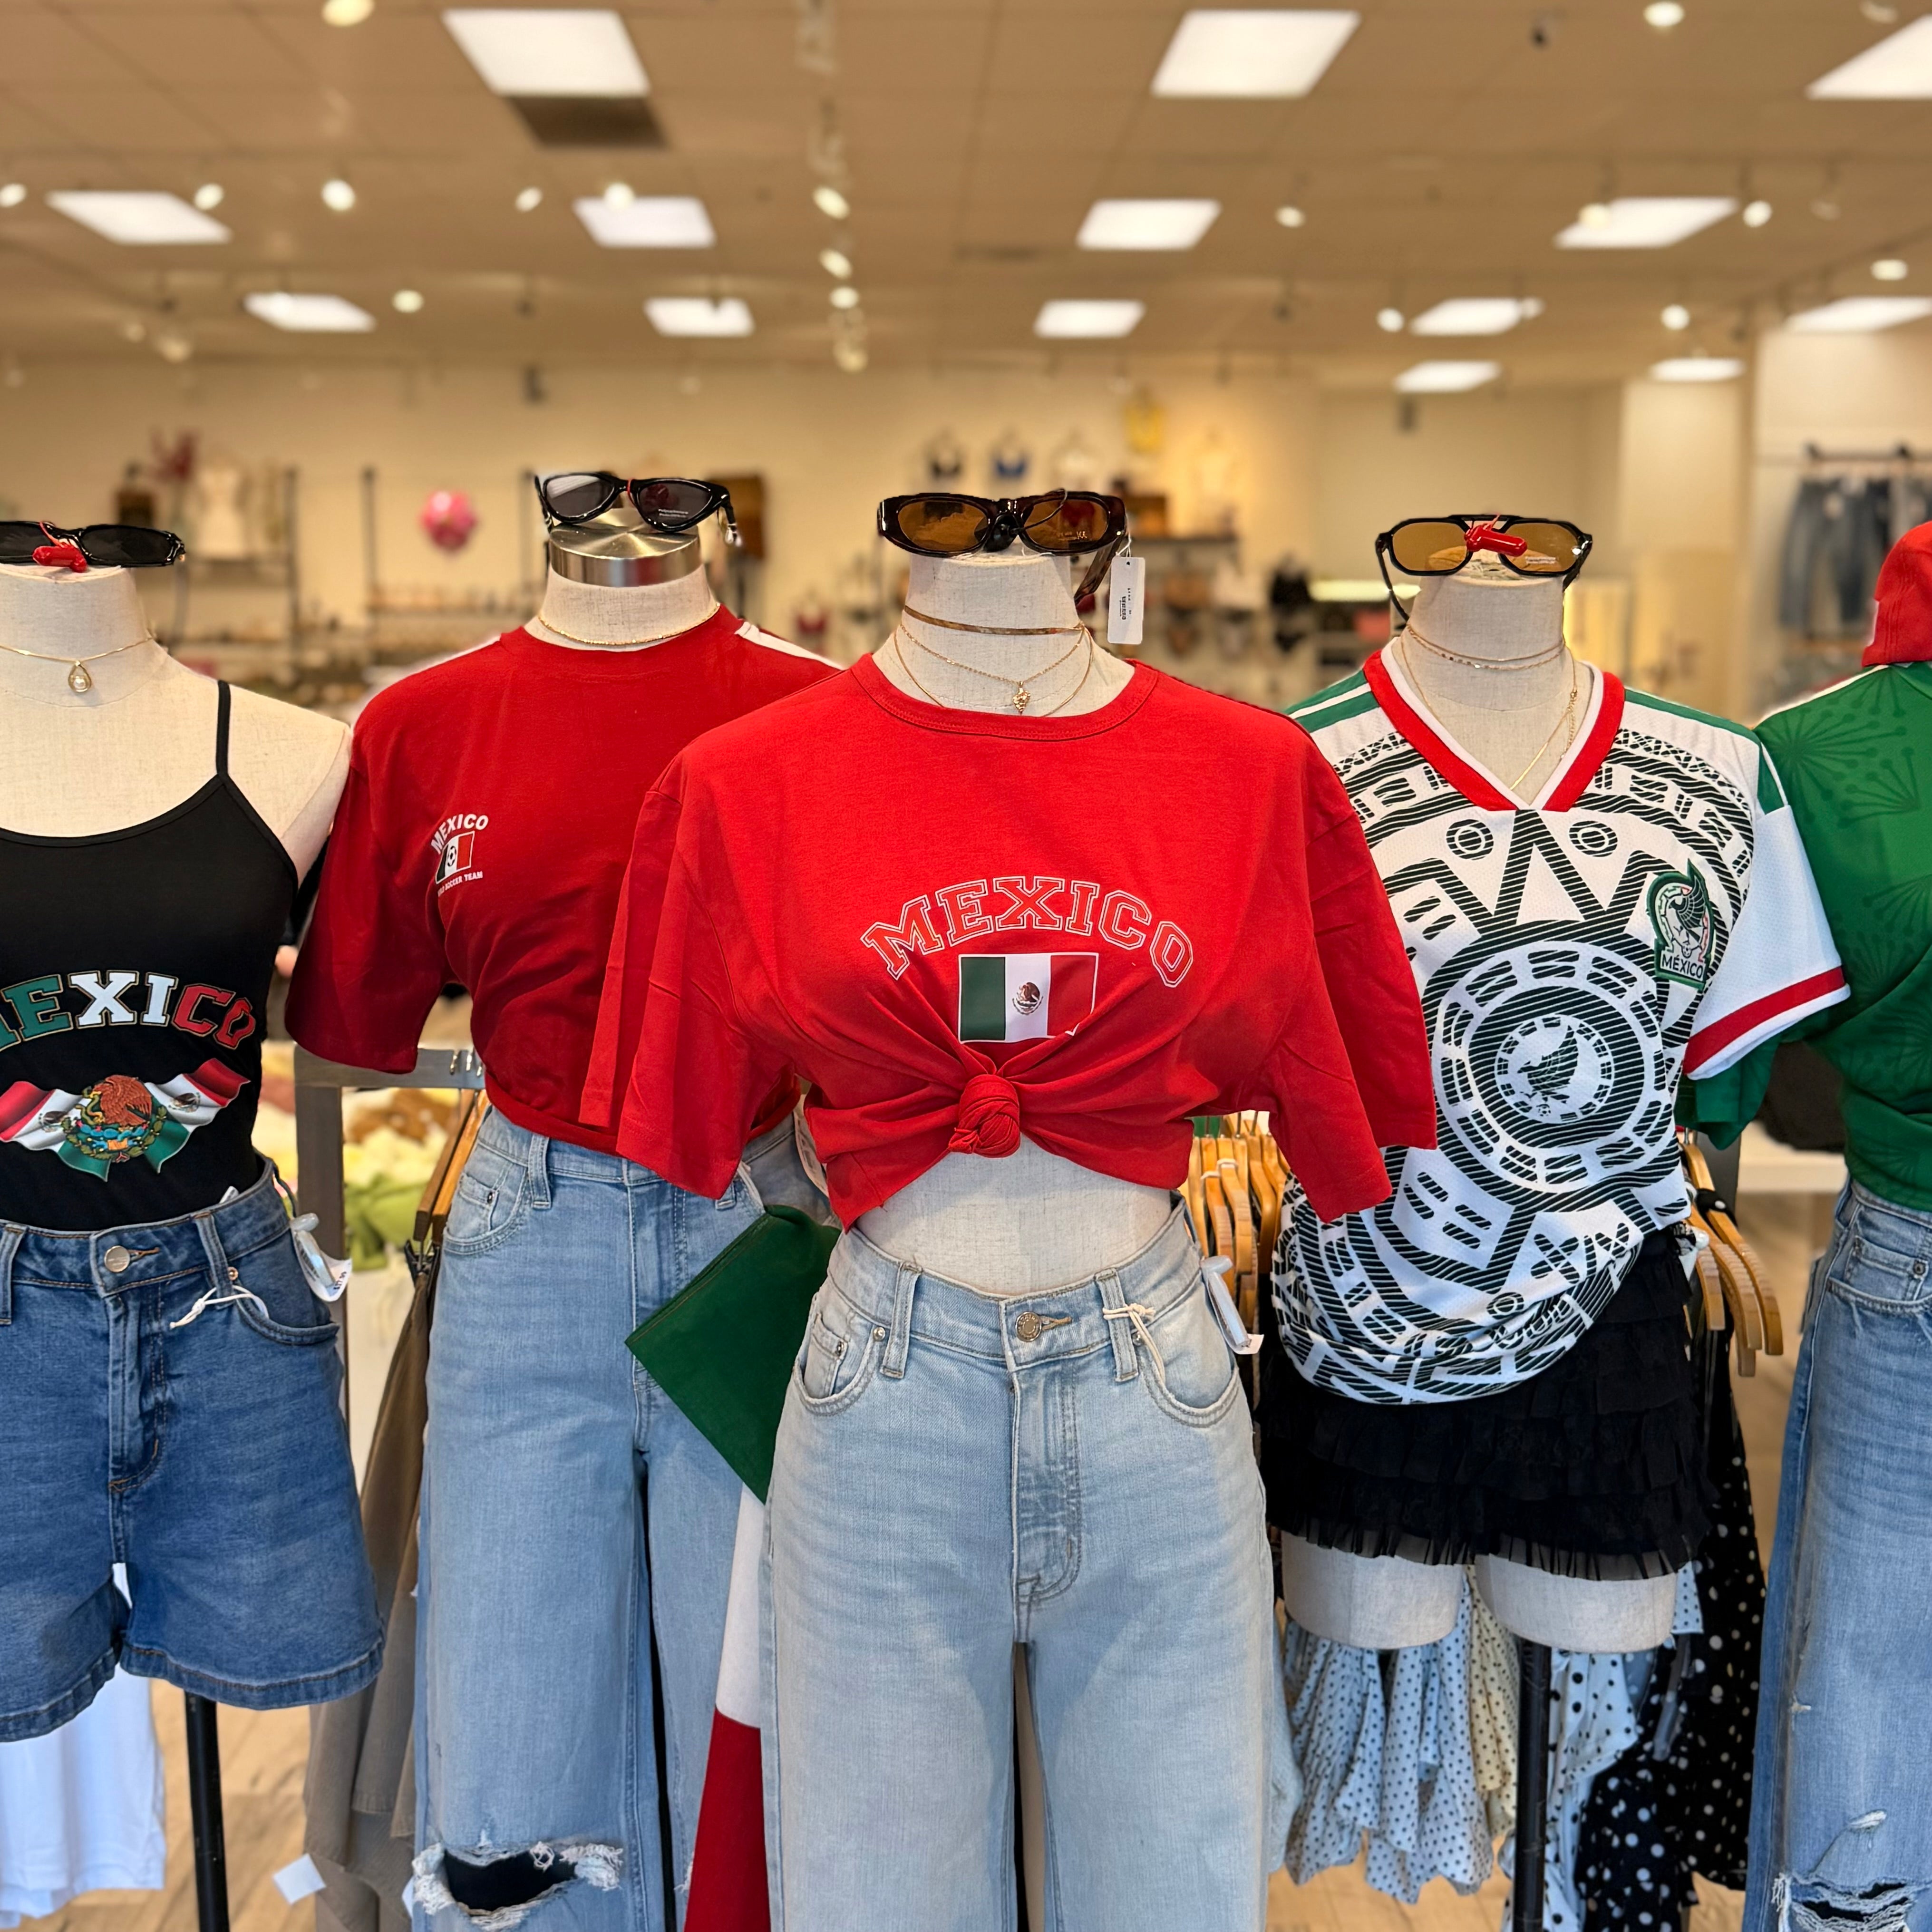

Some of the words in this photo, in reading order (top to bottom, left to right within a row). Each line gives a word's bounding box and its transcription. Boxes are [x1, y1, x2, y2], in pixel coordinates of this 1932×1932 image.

[431, 814, 489, 854] MEXICO
[464, 871, 483, 882] TEAM
[860, 875, 1193, 988] MEXICO
[1662, 954, 1704, 979] MÉXICO
